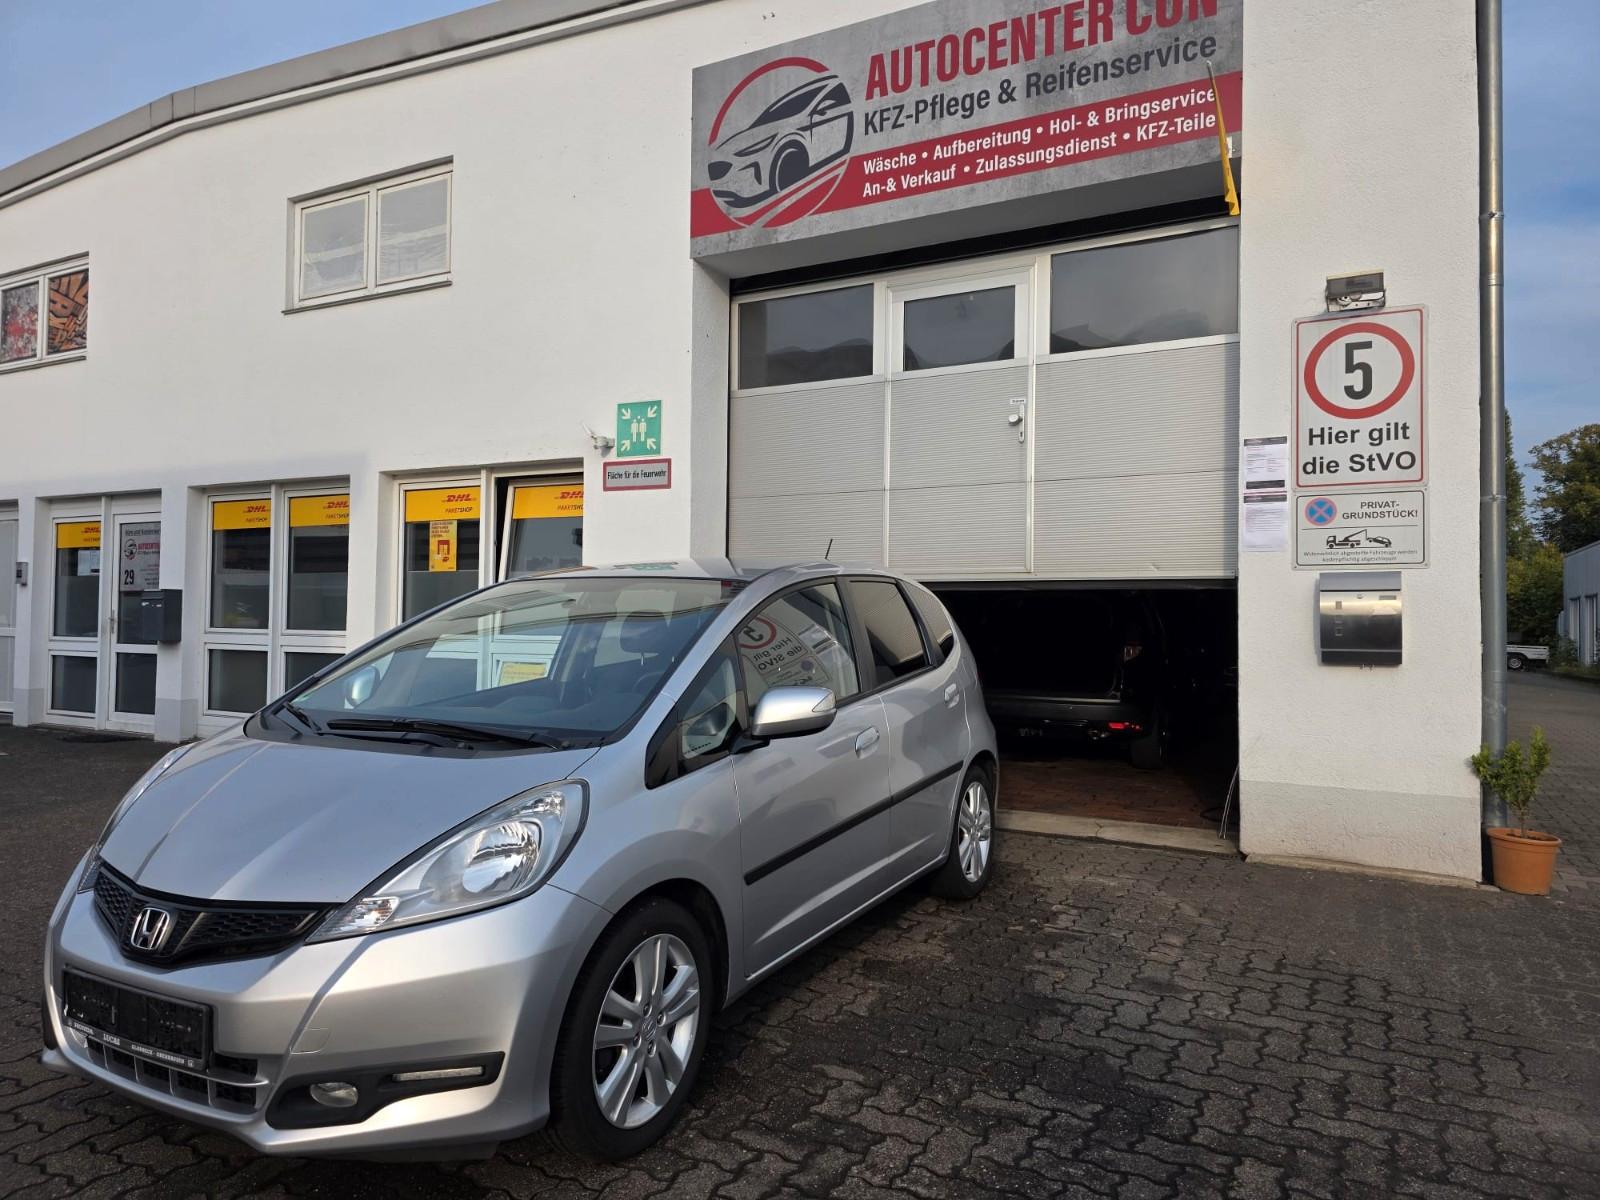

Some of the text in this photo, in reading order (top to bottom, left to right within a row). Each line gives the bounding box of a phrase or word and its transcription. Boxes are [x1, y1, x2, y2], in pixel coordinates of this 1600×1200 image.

[865, 0, 1114, 100] AUTOCENTER
[864, 36, 1217, 136] KFZ-Pflege & Reifenservice
[863, 88, 1215, 175] Wäsche Aufbereitung Hol- & Bringservice
[901, 163, 957, 190] Verkauf
[975, 131, 1117, 175] Zulassungsdienst
[1136, 112, 1217, 142] KFZ-Teile
[1343, 340, 1373, 400] 5
[1307, 421, 1410, 447] Hier gilt
[1301, 455, 1340, 476] die
[1348, 450, 1417, 473] StVO
[607, 469, 667, 480] Fläche für die Feuerwehr
[327, 501, 349, 509] DHL
[447, 493, 472, 503] DHL
[1360, 500, 1400, 510] PRIVAT-
[247, 505, 266, 513] DHL
[557, 503, 584, 511] PAKETSHO
[1342, 509, 1418, 520] GRUNDSTÜCK!
[124, 569, 135, 586] 29
